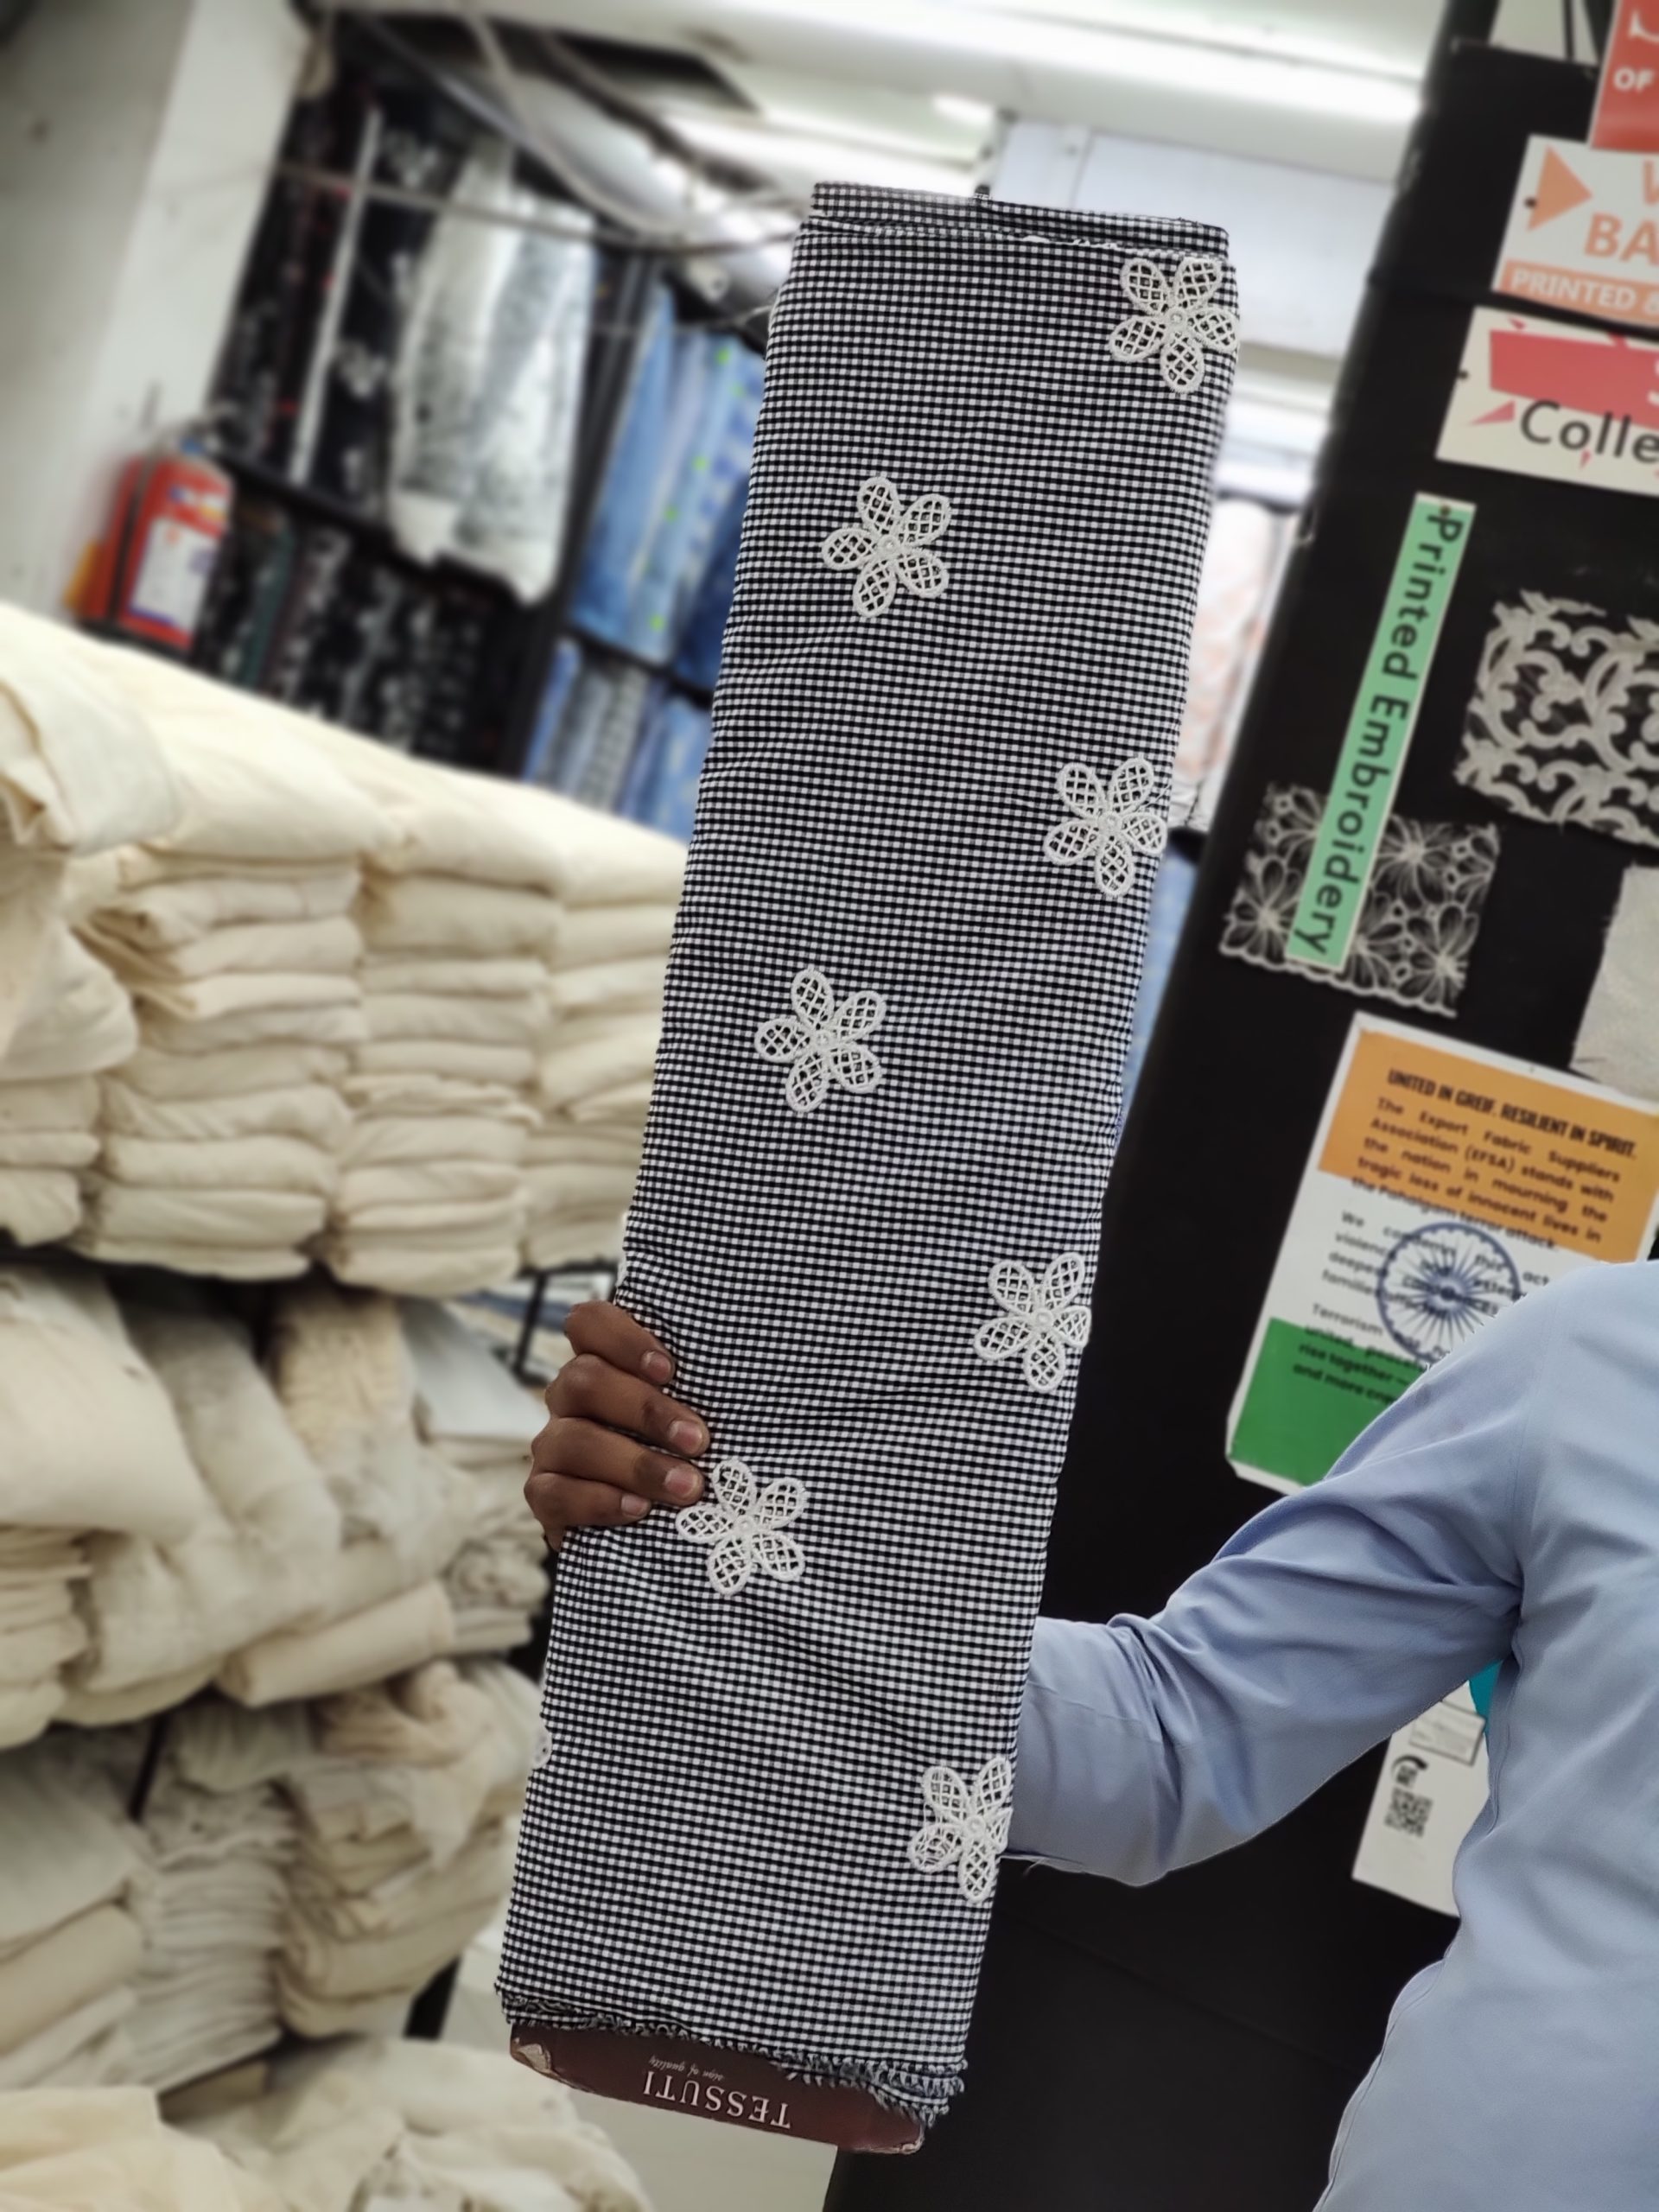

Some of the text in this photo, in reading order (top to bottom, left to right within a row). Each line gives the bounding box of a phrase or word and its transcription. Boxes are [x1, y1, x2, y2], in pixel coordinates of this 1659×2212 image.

[1613, 67, 1656, 93] OF
[1510, 267, 1637, 312] PRINTED
[1293, 512, 1465, 956] Printed Embroidery
[1387, 1069, 1437, 1096] UNITED
[1437, 1084, 1454, 1102] IN
[1500, 1103, 1568, 1137] RESILIENT
[1568, 1123, 1586, 1142] IN
[1370, 1117, 1615, 1203] Association (EFSA) stands with
[1377, 1096, 1620, 1183] The Export Fabric Suppliers
[1351, 1174, 1376, 1193] the
[1378, 1183, 1458, 1217] Pahalgam
[1459, 1209, 1504, 1232] terror
[1357, 1155, 1602, 1243] tragic loss of innocent lives in
[1363, 1136, 1608, 1223] the nation in mourning the
[1341, 1211, 1365, 1228] We
[1313, 1302, 1384, 1336] Terrorism
[1293, 1363, 1365, 1395] and more
[1298, 1343, 1393, 1382] rise together
[648, 2055, 685, 2073] quality
[687, 2062, 699, 2078] of
[643, 2070, 791, 2129] TESSUTI
